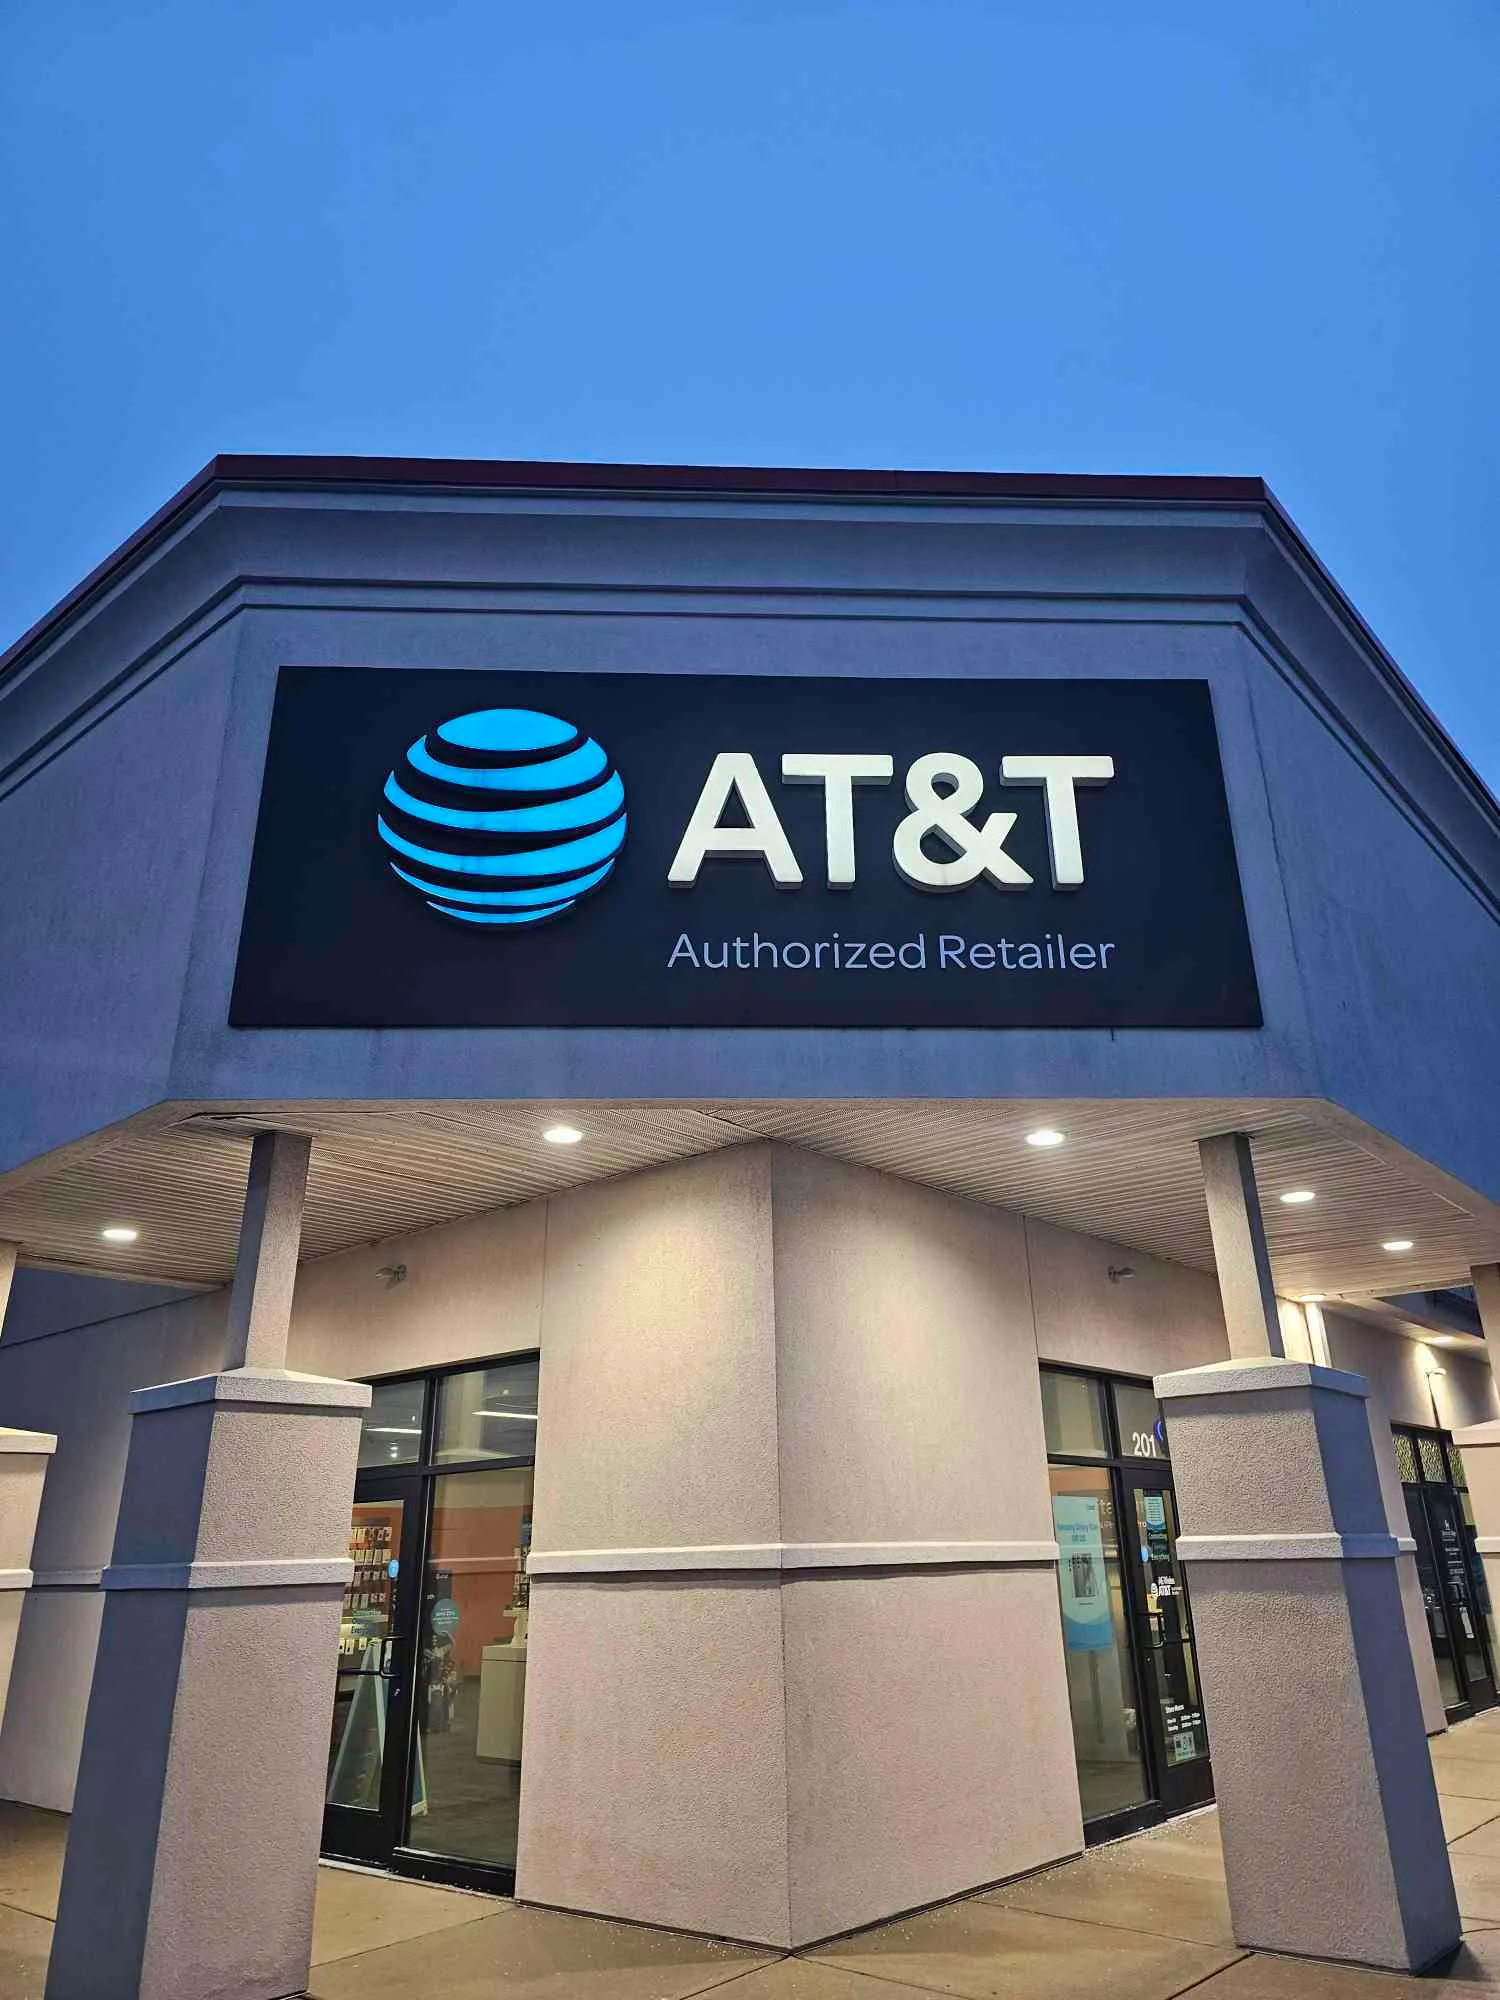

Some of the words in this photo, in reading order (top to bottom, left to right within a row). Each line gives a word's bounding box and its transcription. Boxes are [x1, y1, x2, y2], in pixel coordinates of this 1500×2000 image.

[667, 752, 1115, 890] AT&T
[667, 932, 925, 970] Authorized
[940, 933, 1115, 970] Retailer
[1132, 1431, 1157, 1458] 201
